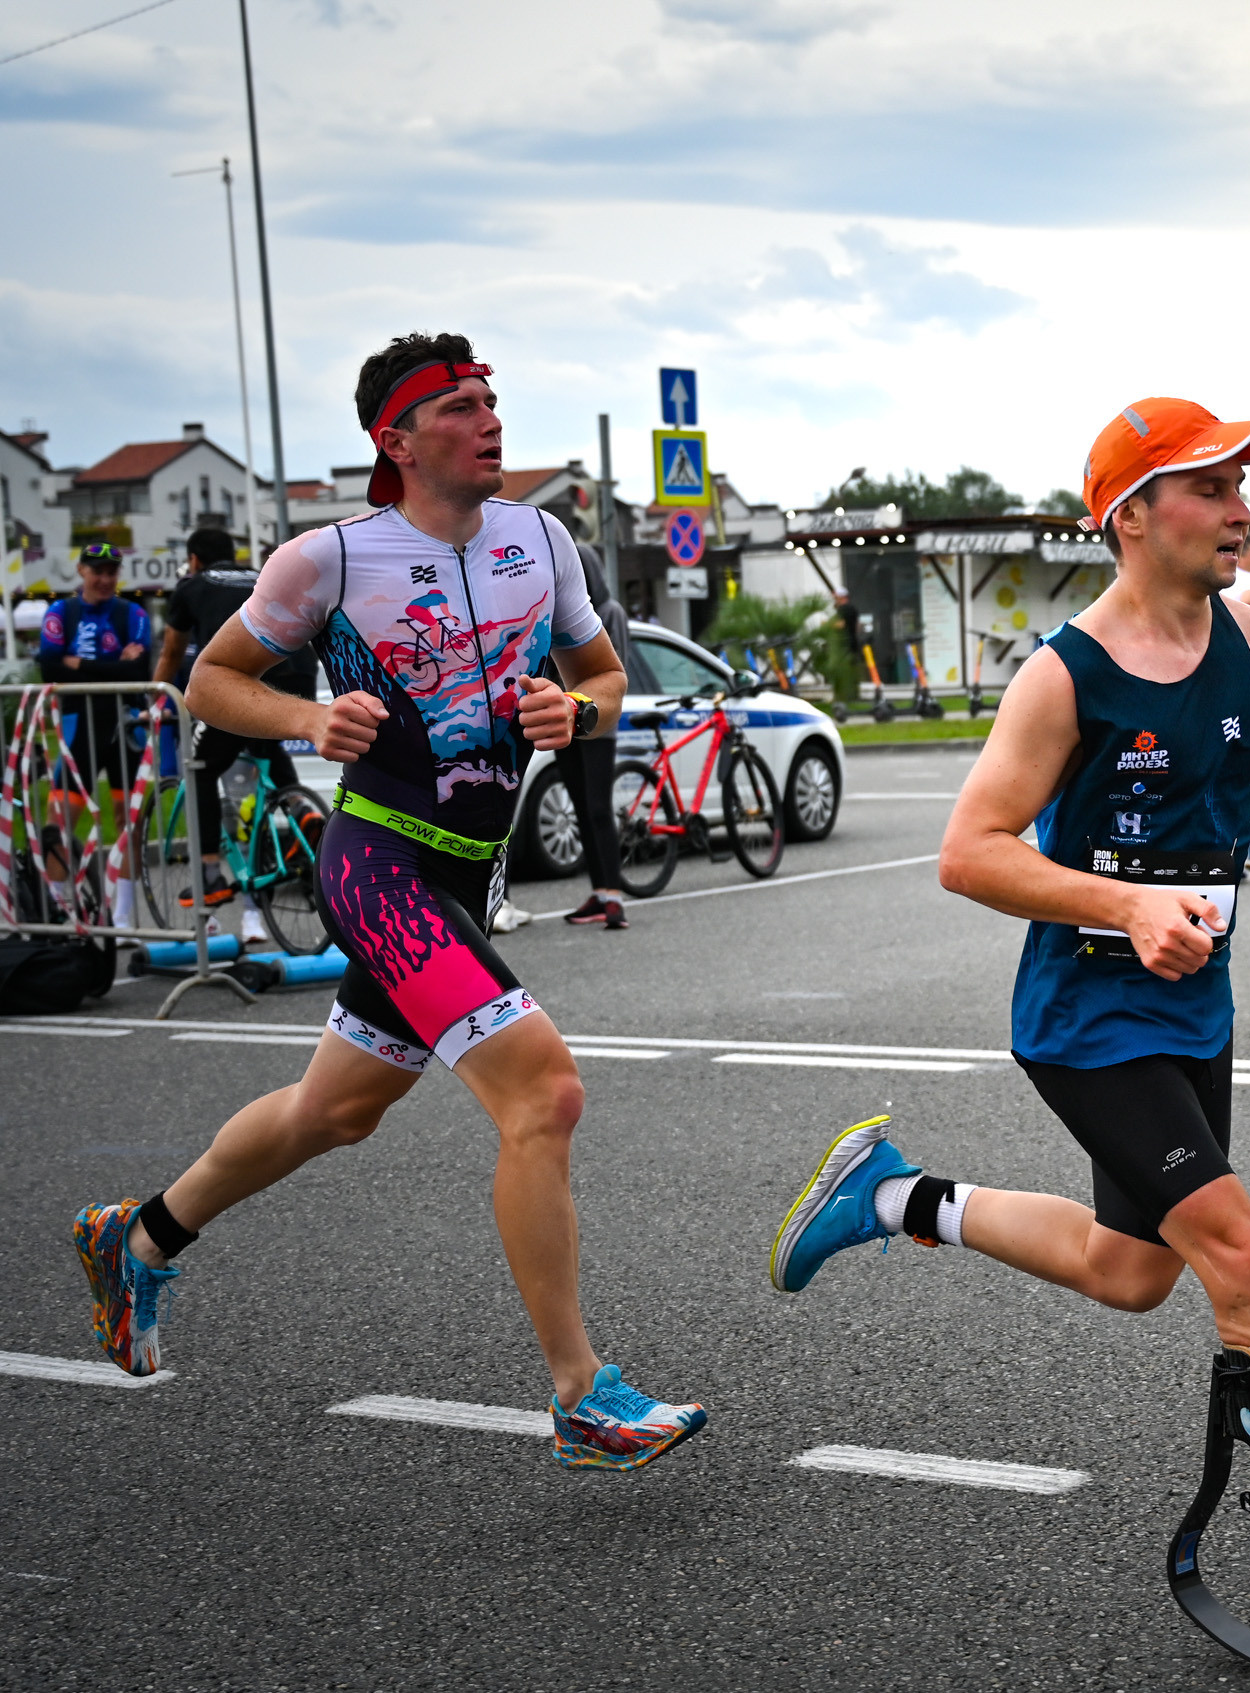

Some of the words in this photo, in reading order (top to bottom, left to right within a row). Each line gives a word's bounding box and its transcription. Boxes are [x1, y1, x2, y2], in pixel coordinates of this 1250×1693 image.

[1192, 443, 1223, 456] 2XU
[491, 558, 536, 577] Преодолей
[1121, 749, 1168, 762] ИНТЕР
[1094, 849, 1112, 860] IRON
[1092, 859, 1119, 873] STAR
[1162, 1150, 1197, 1172] Kalenji
